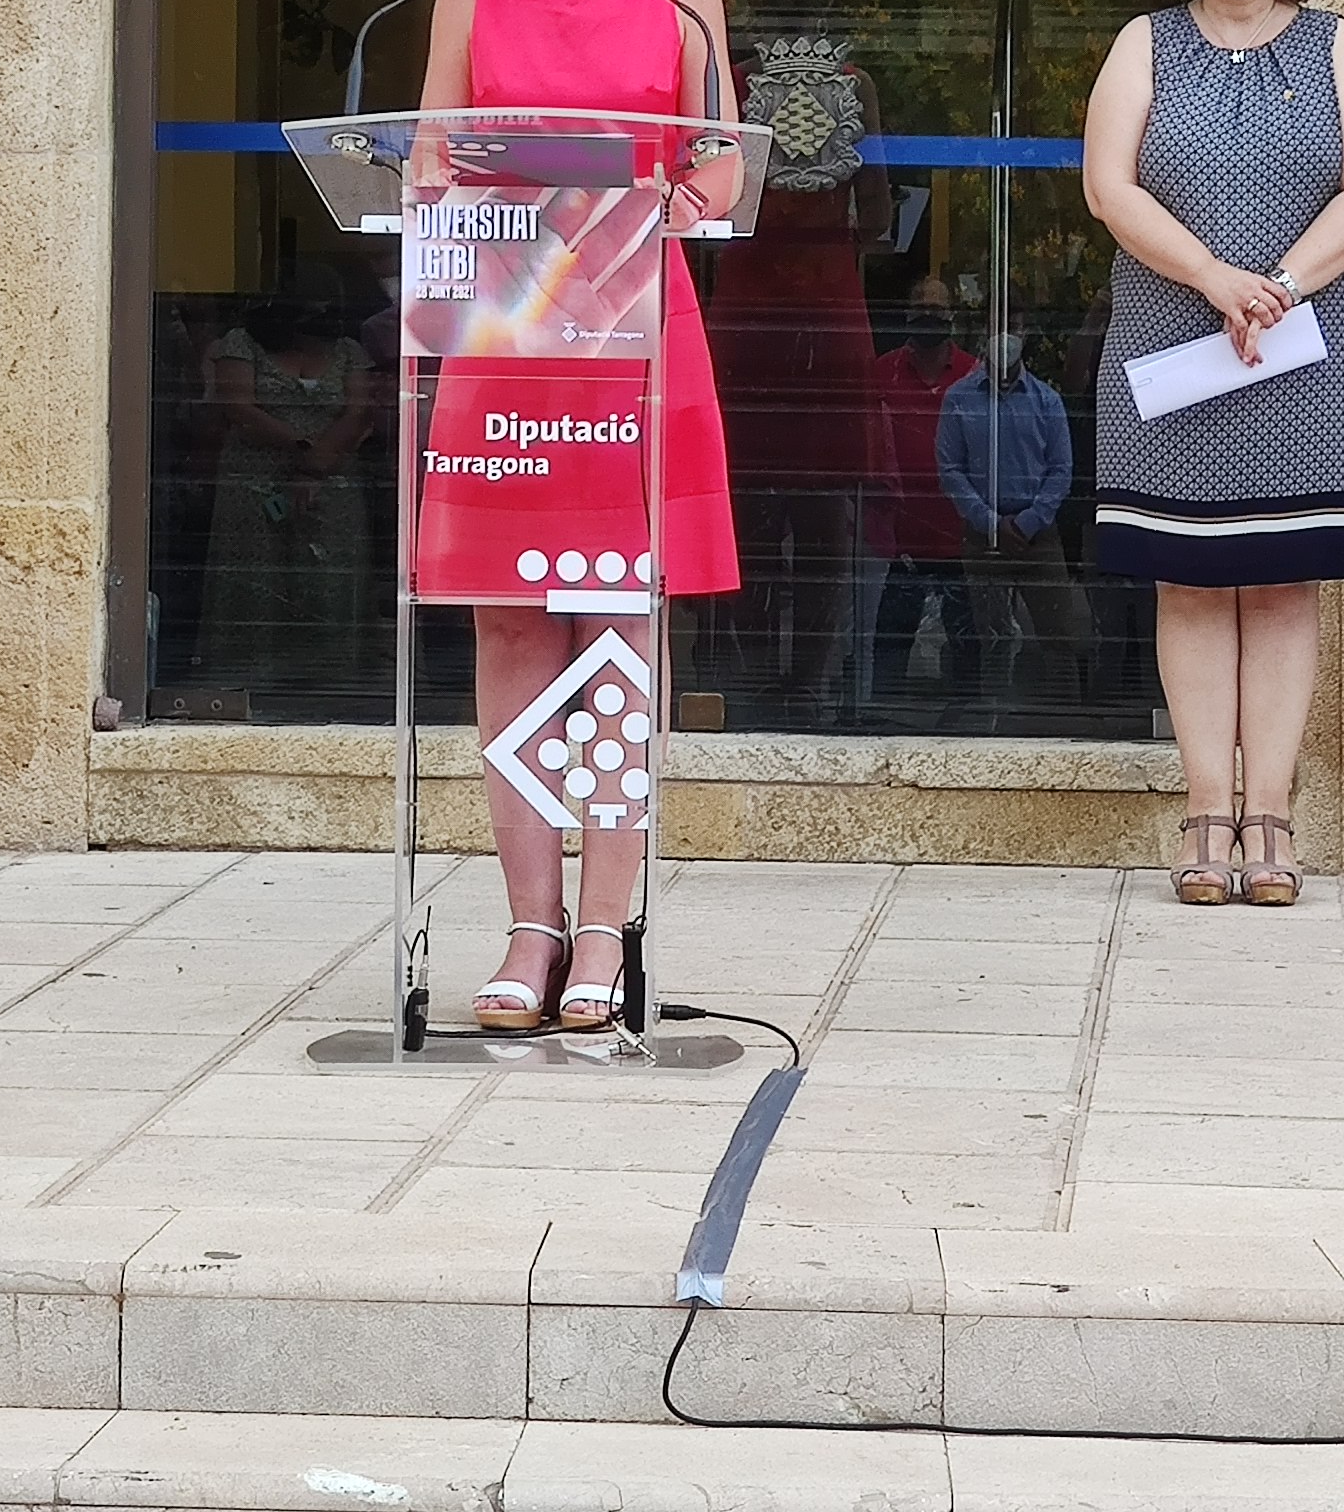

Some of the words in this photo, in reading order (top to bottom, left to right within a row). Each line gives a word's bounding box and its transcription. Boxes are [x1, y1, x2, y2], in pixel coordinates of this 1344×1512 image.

[416, 204, 540, 240] DIVERSITAT
[416, 245, 476, 281] LGTBI
[429, 284, 451, 300] JUNY
[452, 284, 475, 300] 2021
[485, 412, 640, 450] Diputació
[422, 450, 550, 481] Tarragona
